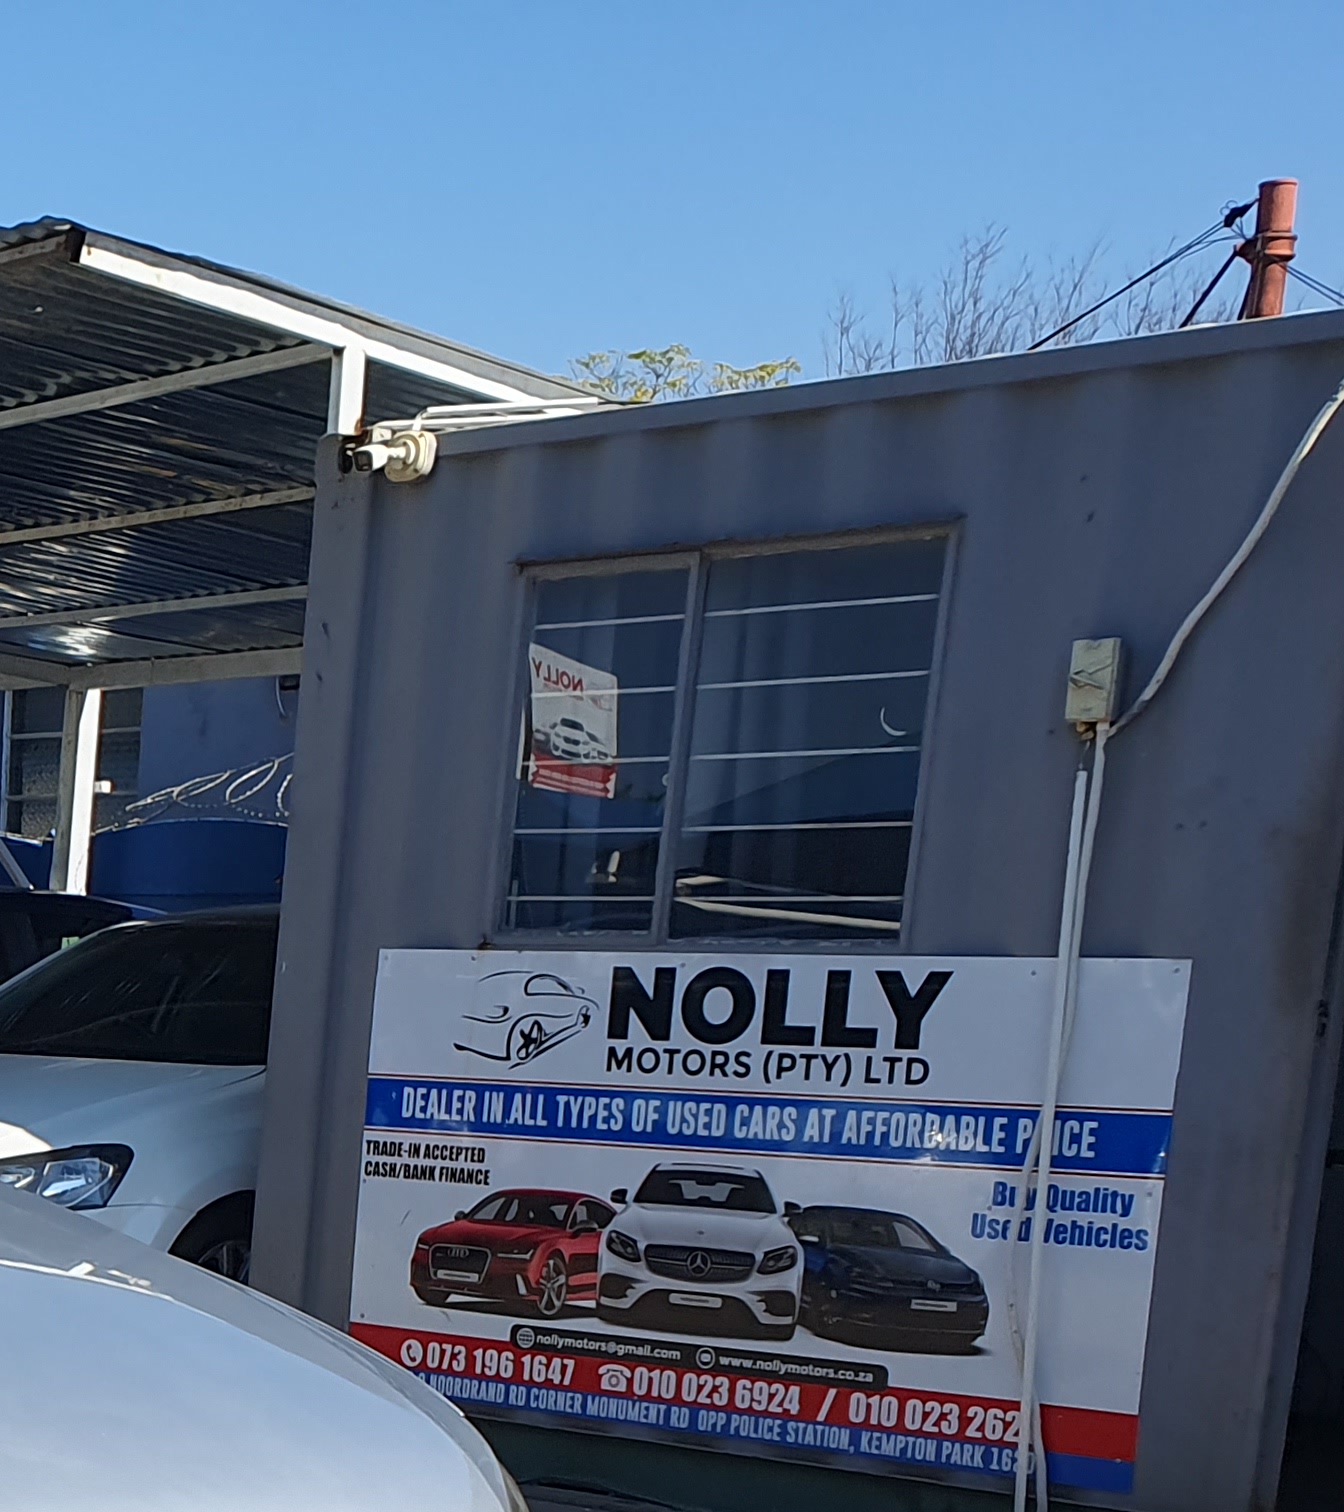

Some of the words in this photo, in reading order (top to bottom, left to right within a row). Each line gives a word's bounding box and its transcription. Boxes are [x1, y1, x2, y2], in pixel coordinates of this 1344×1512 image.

[607, 965, 955, 1050] NOLLY
[606, 1046, 753, 1078] MOTORS
[763, 1050, 852, 1087] (PTY)
[863, 1055, 930, 1086] LTD
[401, 1086, 476, 1123] DEALER
[482, 1091, 504, 1124] IN
[508, 1093, 548, 1127] ALL
[556, 1095, 623, 1131] TYPES
[631, 1098, 660, 1133] OF
[666, 1100, 726, 1137] USED
[734, 1103, 796, 1142] CARS
[803, 1107, 837, 1144] AT
[841, 1109, 1007, 1153] AFFORDABLE
[1015, 1117, 1099, 1158] PICE
[365, 1140, 421, 1159] TRADE-IN
[423, 1143, 486, 1164] ACCEPTED
[364, 1161, 437, 1182] CASH/BANK
[438, 1166, 491, 1186] FINANCE
[1046, 1183, 1135, 1217] Quality
[426, 1343, 466, 1371] 073
[473, 1348, 515, 1379] 196
[521, 1354, 576, 1385] 1647
[535, 1332, 681, 1361] nollymotors@gmail.com
[718, 1355, 874, 1383] www.nollymotors.co.za
[633, 1366, 677, 1400] 010
[681, 1373, 730, 1407] 023
[734, 1380, 801, 1415] 6924
[848, 1392, 898, 1428] 010
[904, 1399, 960, 1435] 023
[508, 1384, 527, 1406] RD
[529, 1388, 583, 1415] CORNER
[586, 1396, 667, 1426] MONUMENT
[669, 1407, 690, 1429] RD
[697, 1409, 726, 1434] OPP
[730, 1414, 783, 1442] POLICE
[786, 1421, 855, 1454] STATION,
[860, 1432, 936, 1463] KEMPTON
[940, 1440, 986, 1469] PARK
